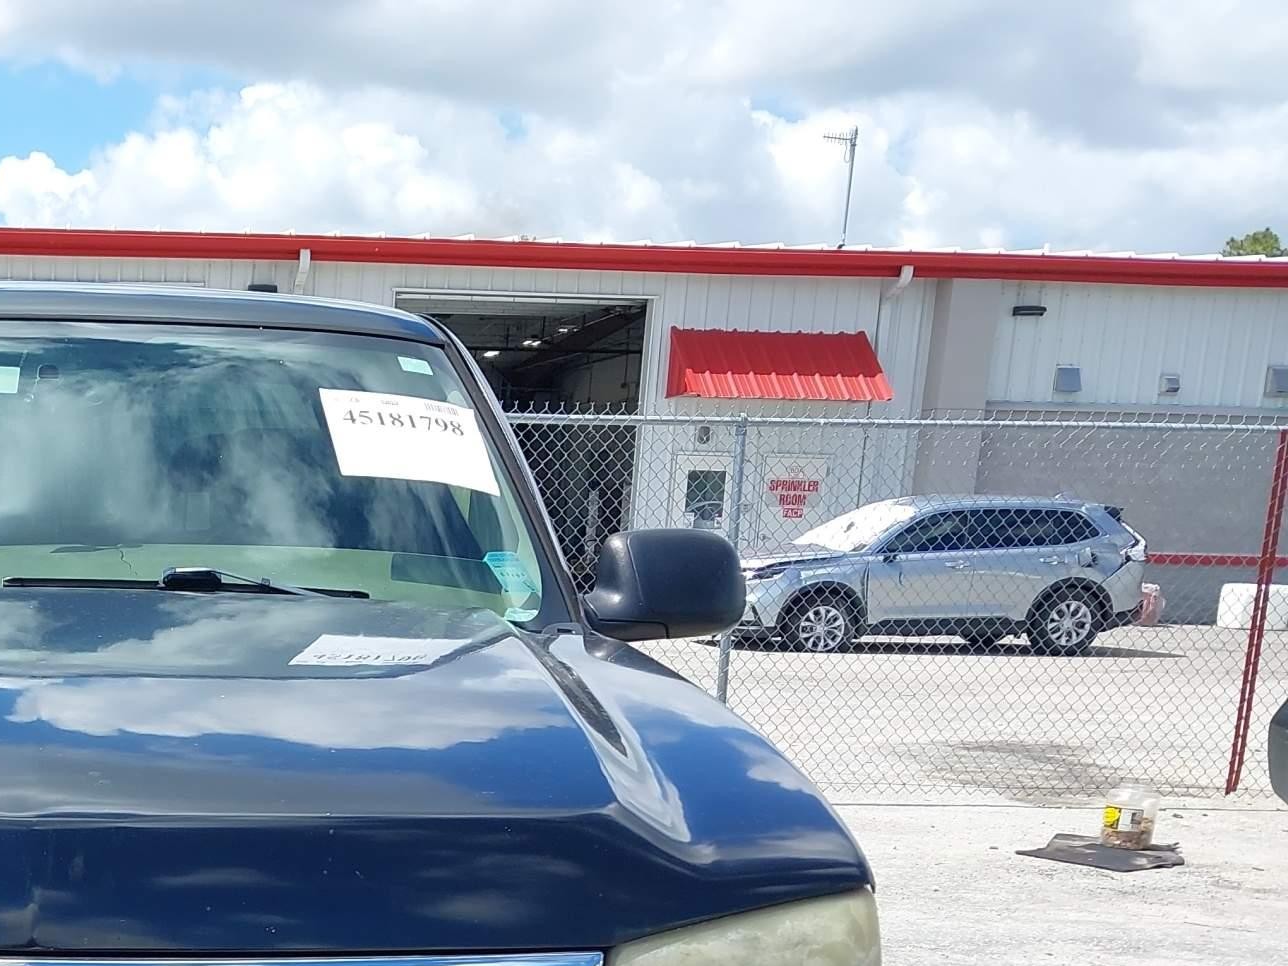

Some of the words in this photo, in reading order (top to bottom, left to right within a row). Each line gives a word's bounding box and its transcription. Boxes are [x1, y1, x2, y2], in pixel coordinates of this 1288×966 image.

[342, 409, 465, 437] 45181798
[769, 479, 819, 492] SPRINKLER
[779, 493, 807, 506] ROOM
